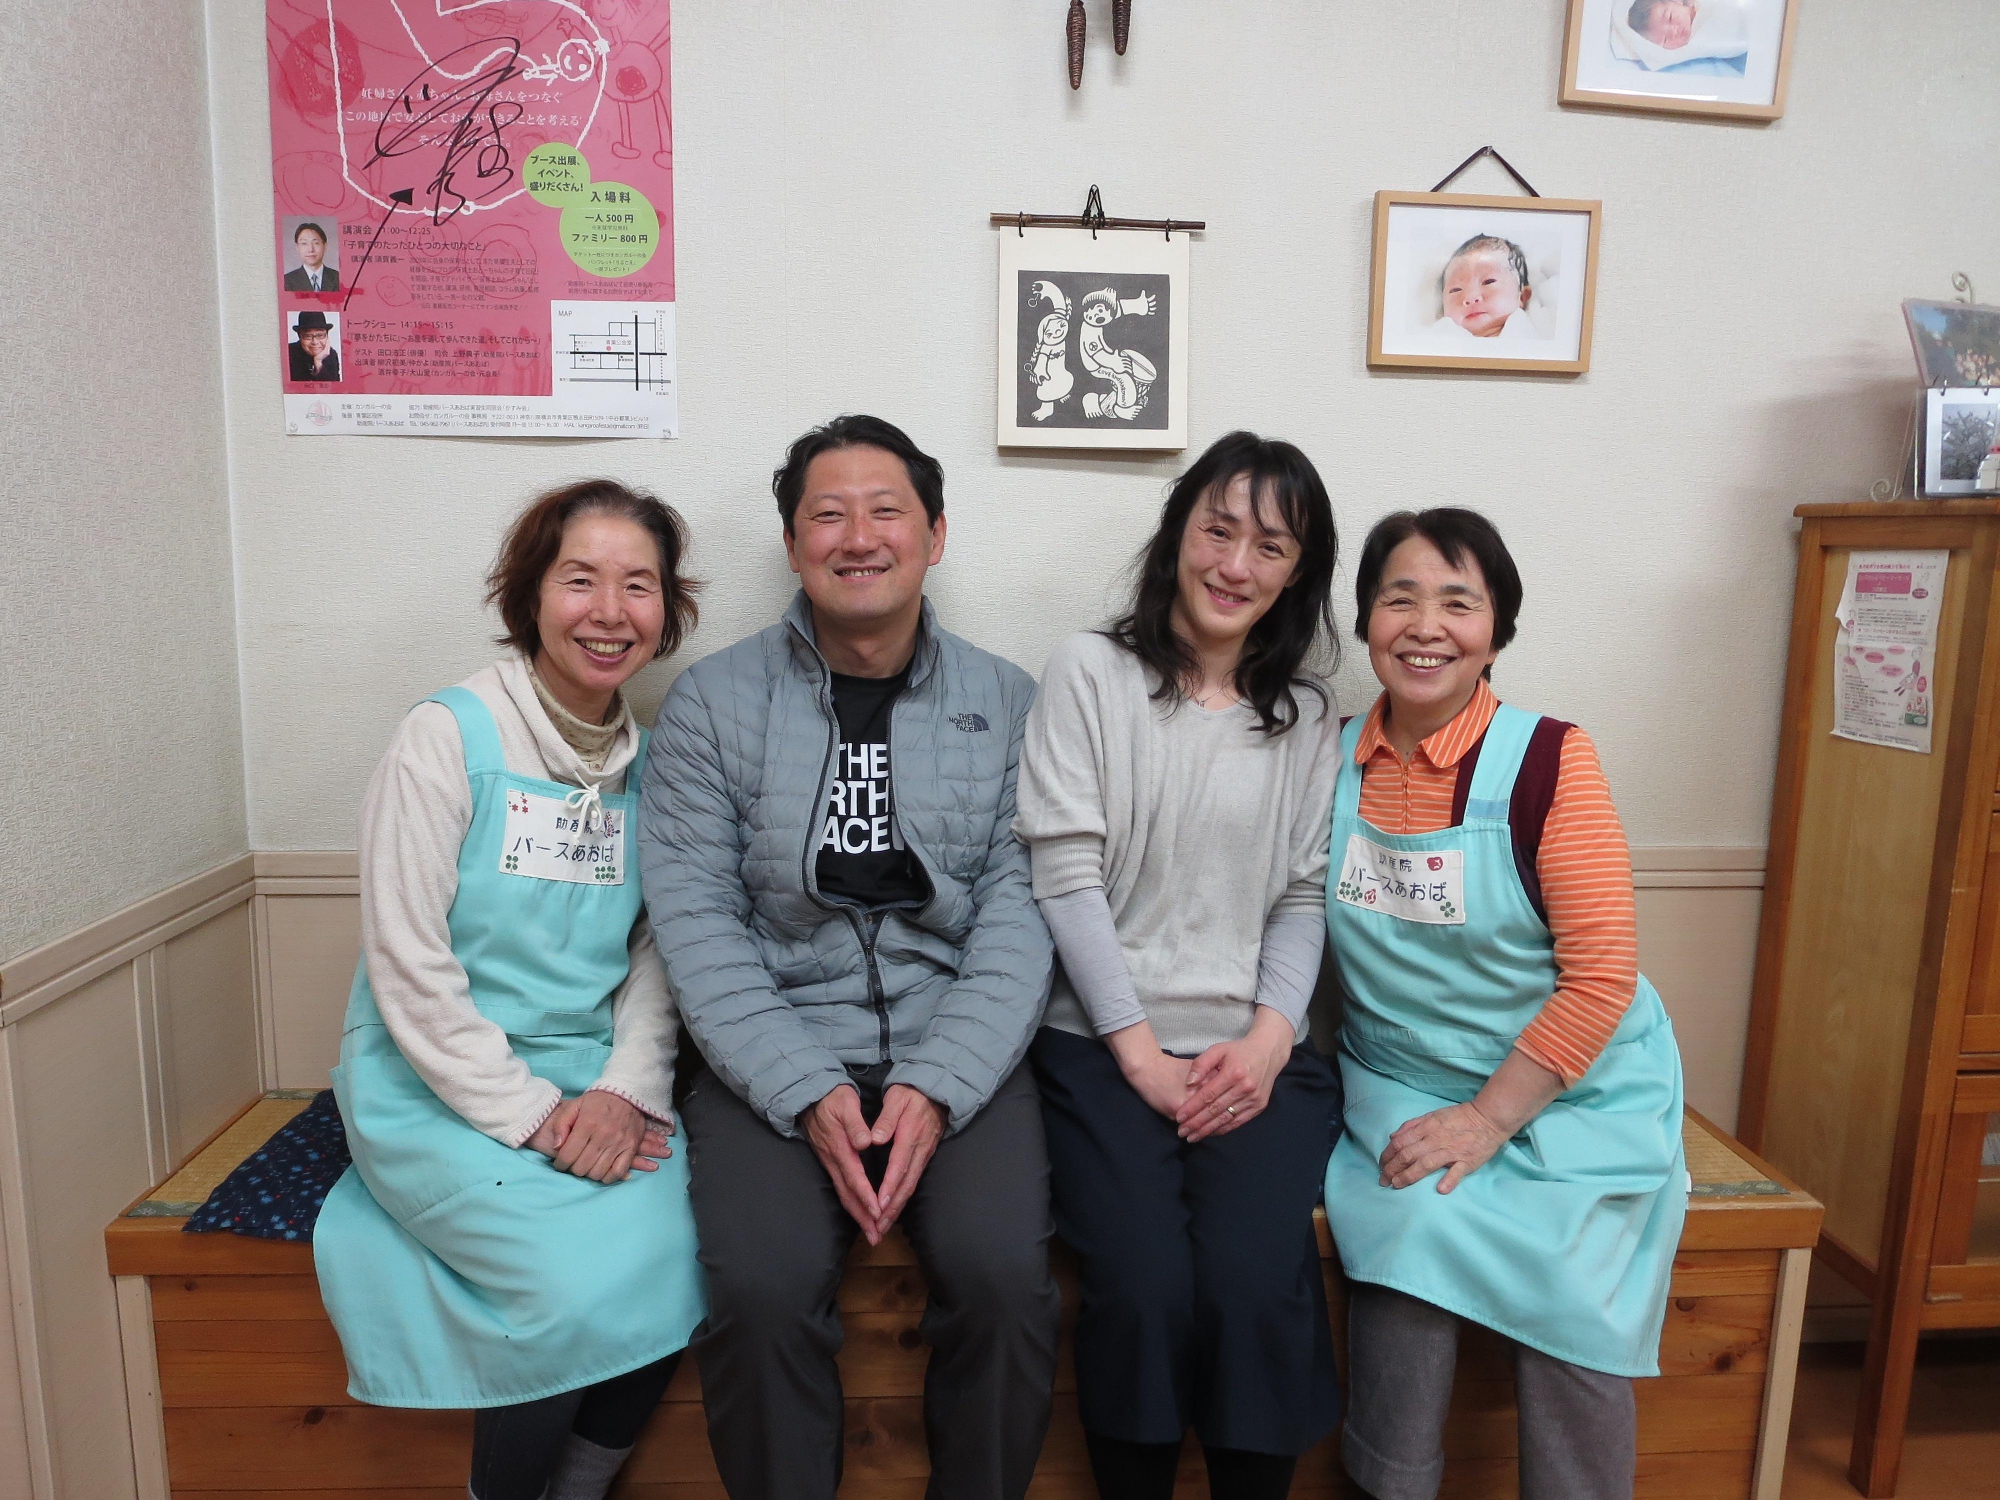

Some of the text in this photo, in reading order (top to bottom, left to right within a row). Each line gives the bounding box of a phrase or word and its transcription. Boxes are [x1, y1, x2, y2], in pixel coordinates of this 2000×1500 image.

[342, 225, 372, 236] 講演会
[346, 319, 396, 329] トークショー
[957, 712, 972, 720] THE
[512, 835, 615, 863] バースあおば
[1348, 865, 1448, 902] バースあおば
